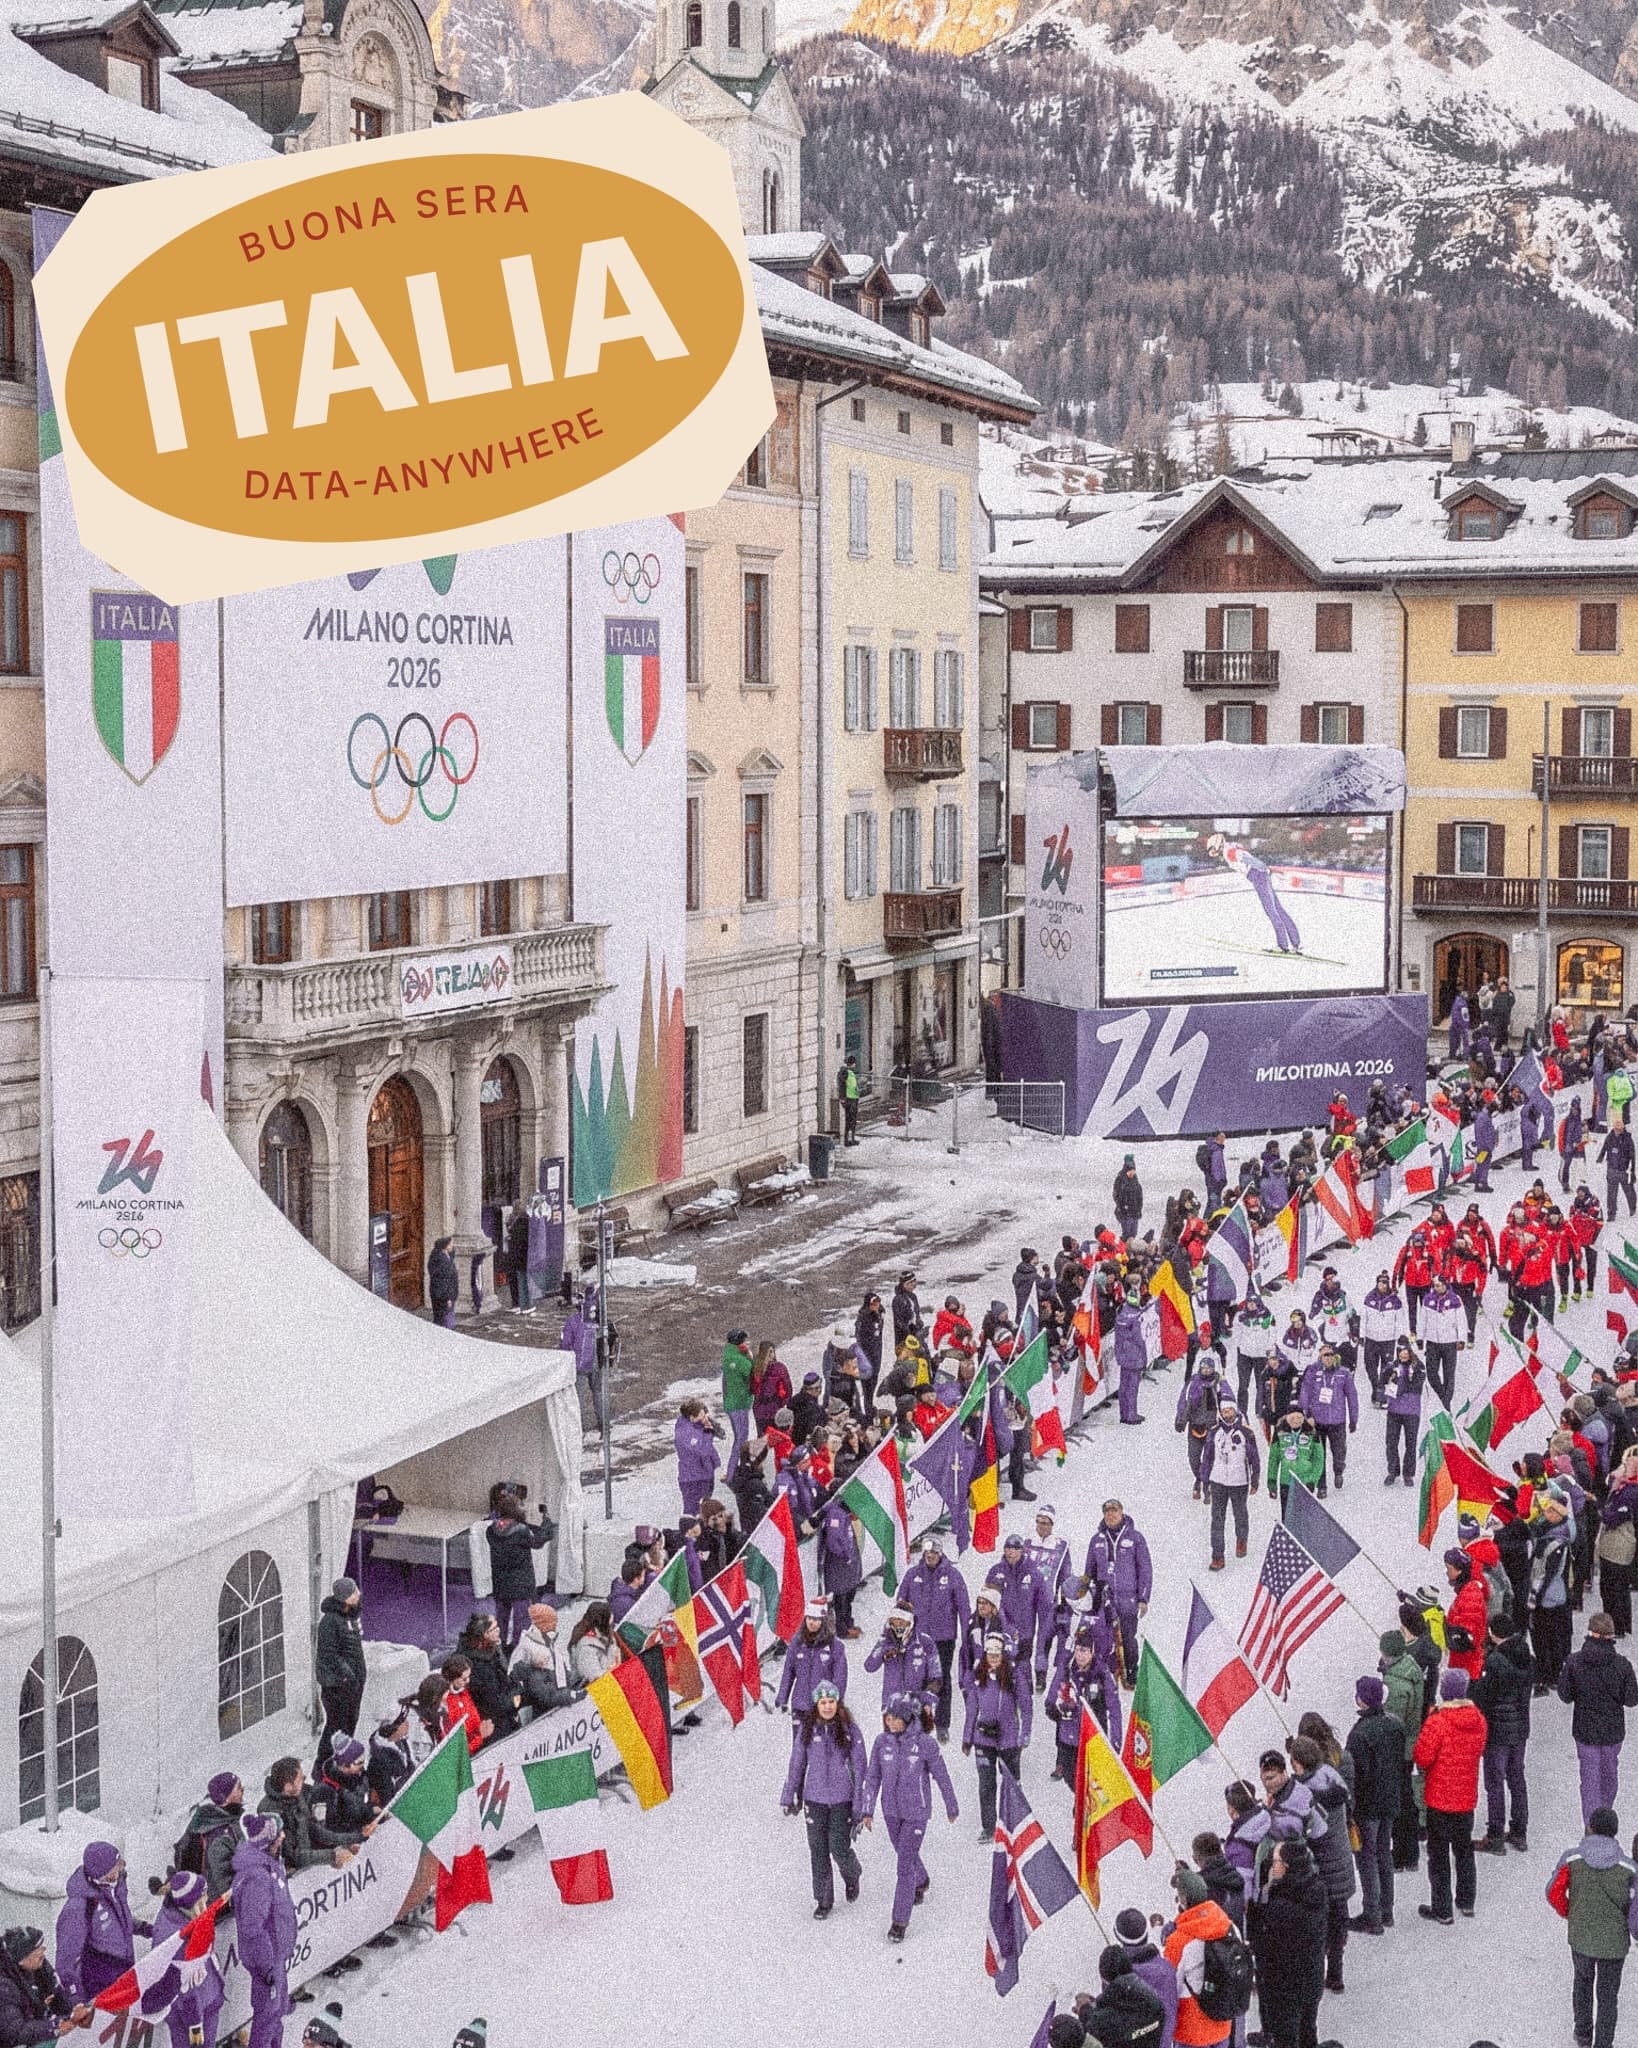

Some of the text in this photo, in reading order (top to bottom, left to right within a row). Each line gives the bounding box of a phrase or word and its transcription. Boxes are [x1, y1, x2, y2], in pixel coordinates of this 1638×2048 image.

[100, 604, 175, 632] ITALIA
[303, 607, 514, 646] MILANO CORTINA
[610, 626, 657, 648] ITALIA
[386, 656, 442, 688] 2026
[1354, 1058, 1395, 1077] 2026
[75, 1199, 185, 1211] MILANO CORTINA
[294, 1857, 378, 1931] ORTINA
